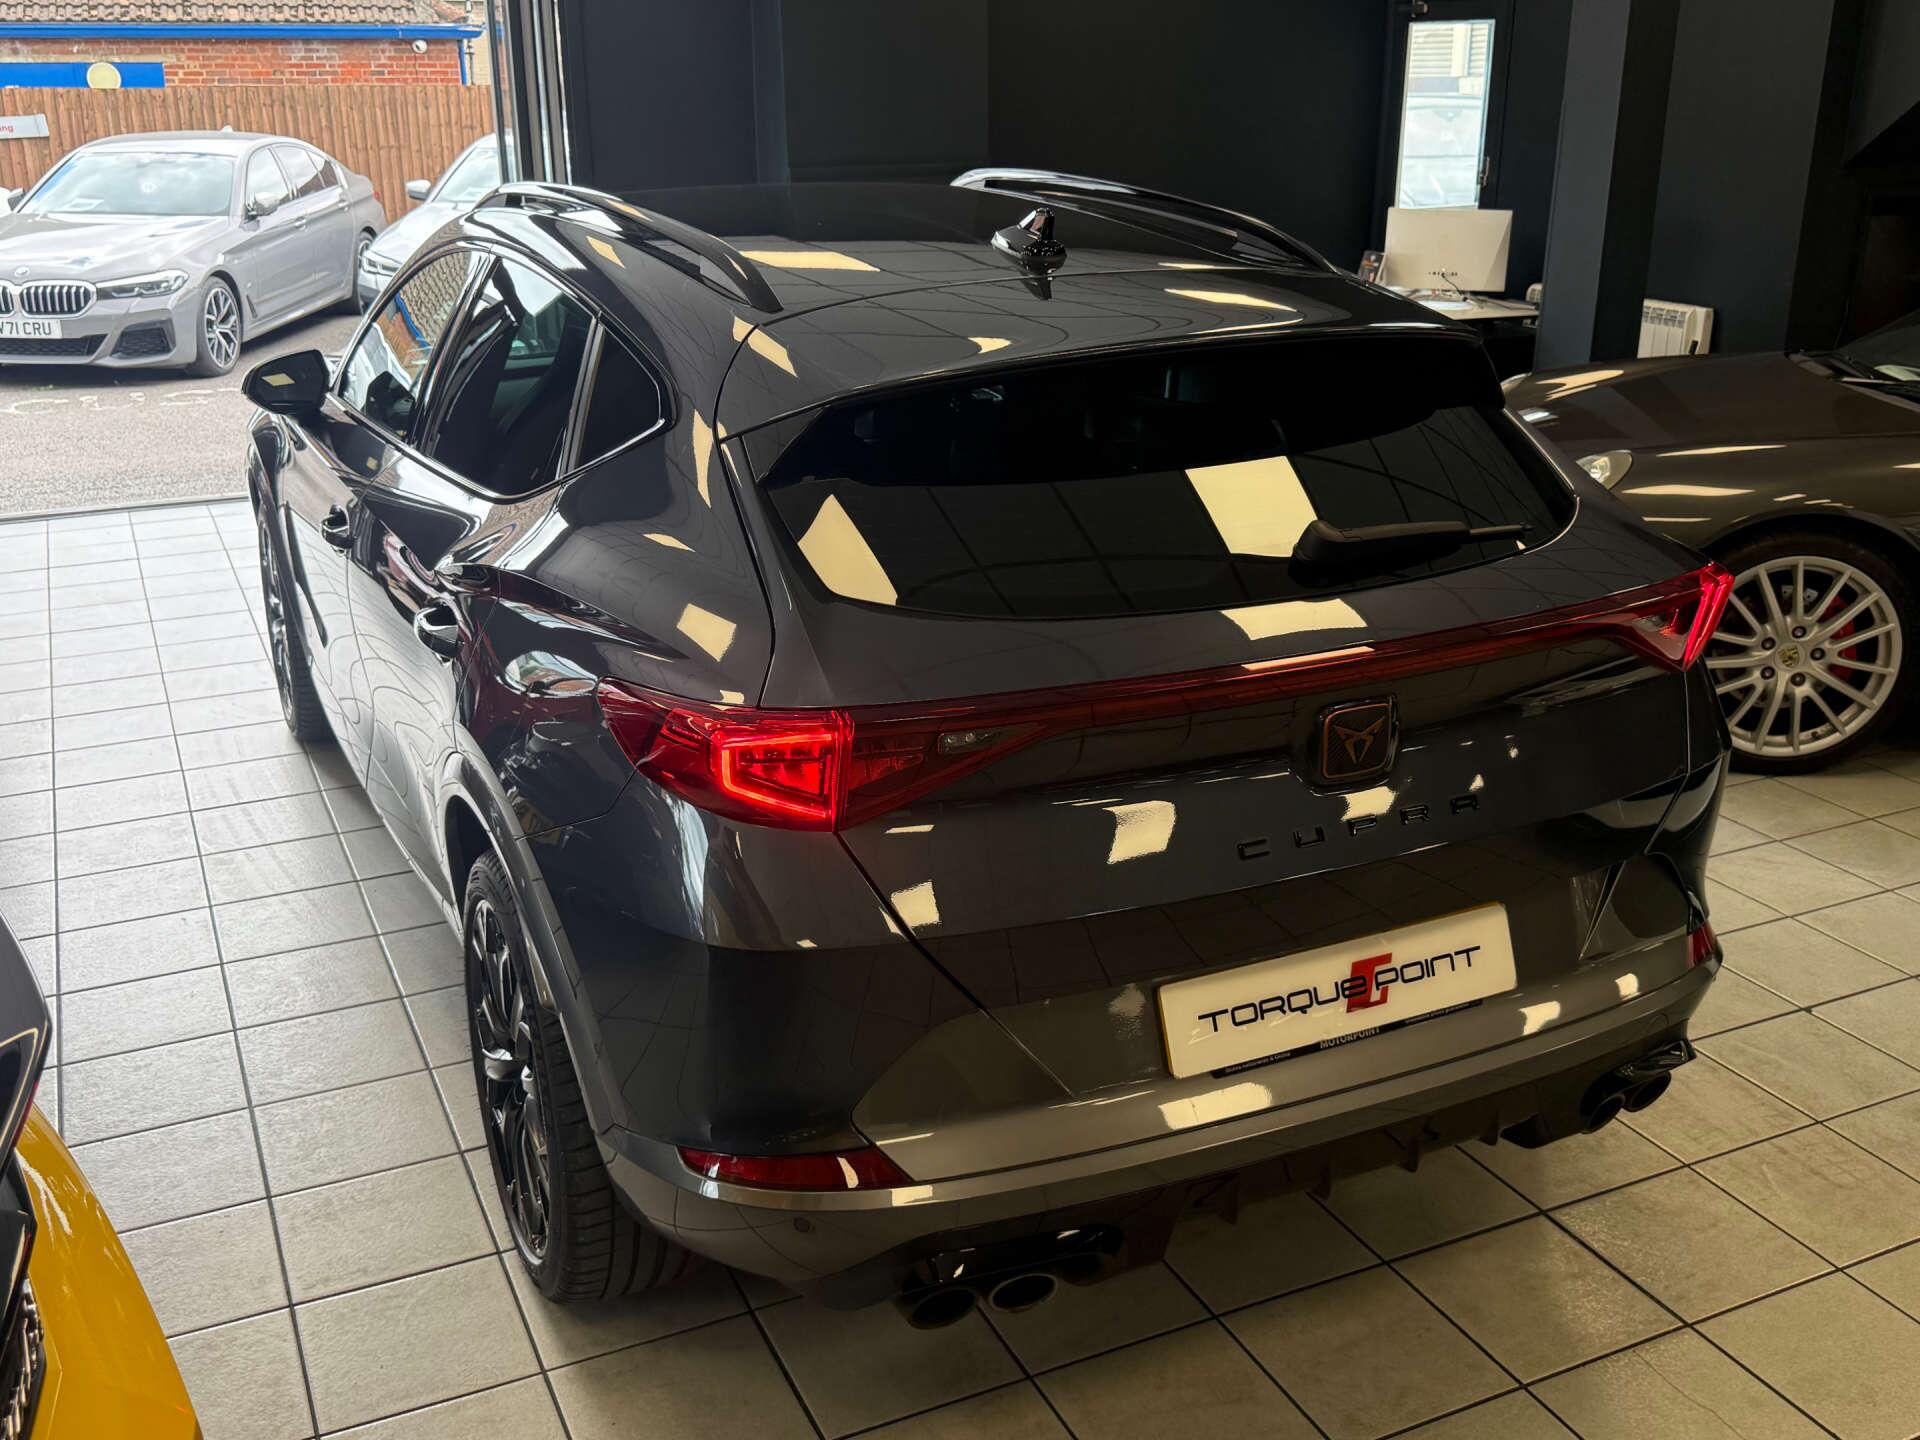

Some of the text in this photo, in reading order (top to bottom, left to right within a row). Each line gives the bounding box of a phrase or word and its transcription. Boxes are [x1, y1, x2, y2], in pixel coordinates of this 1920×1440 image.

[23, 321, 52, 336] CRU
[1236, 793, 1480, 861] CUPRA
[1320, 1026, 1380, 1049] MOTORPOINT
